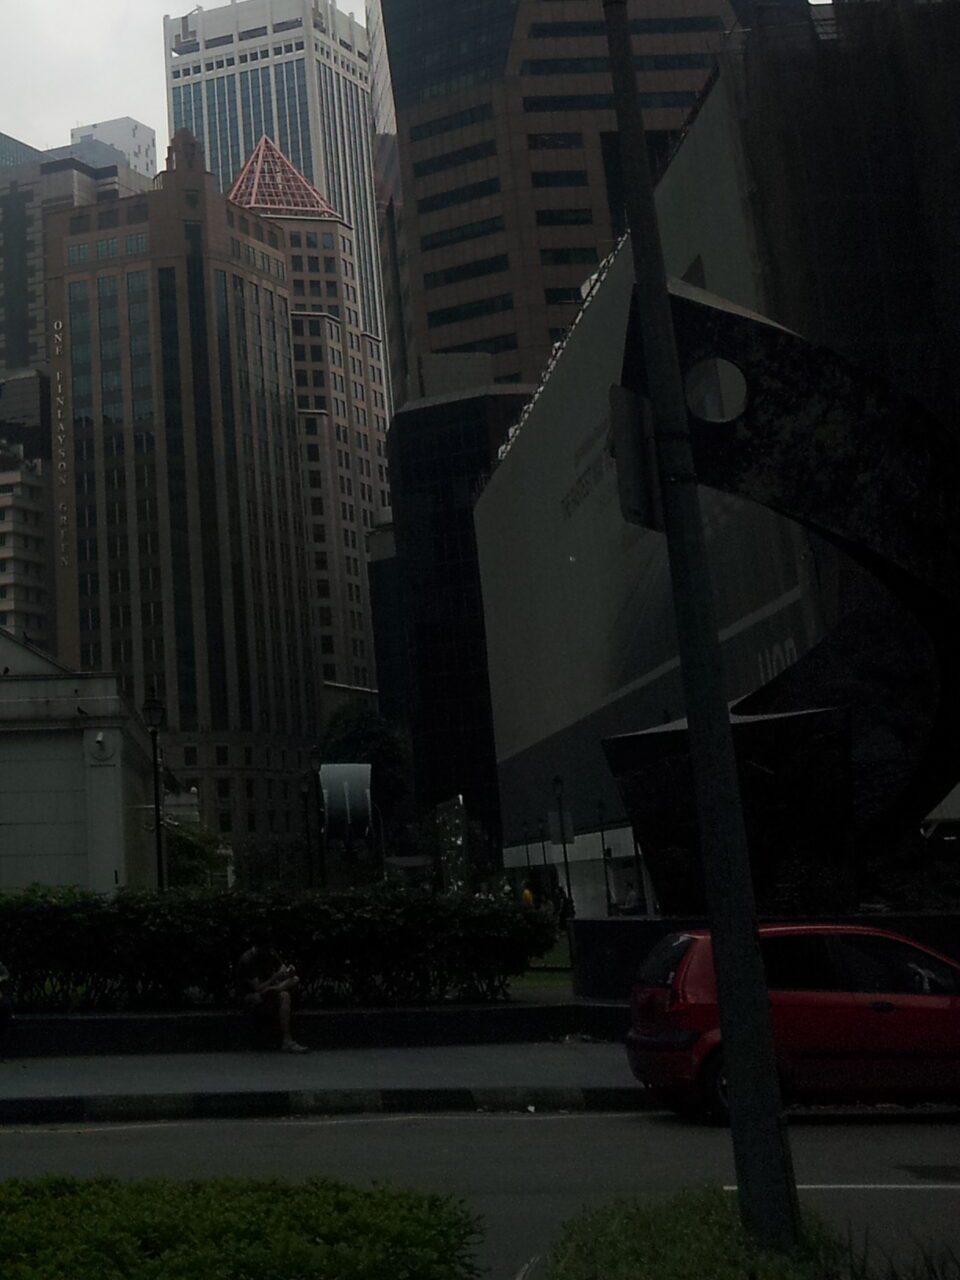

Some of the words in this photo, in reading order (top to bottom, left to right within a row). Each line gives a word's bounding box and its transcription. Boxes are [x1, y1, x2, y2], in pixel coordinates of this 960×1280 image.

[54, 320, 63, 355] ONE
[56, 371, 67, 485] FINLAYSON
[59, 502, 68, 566] GREEN
